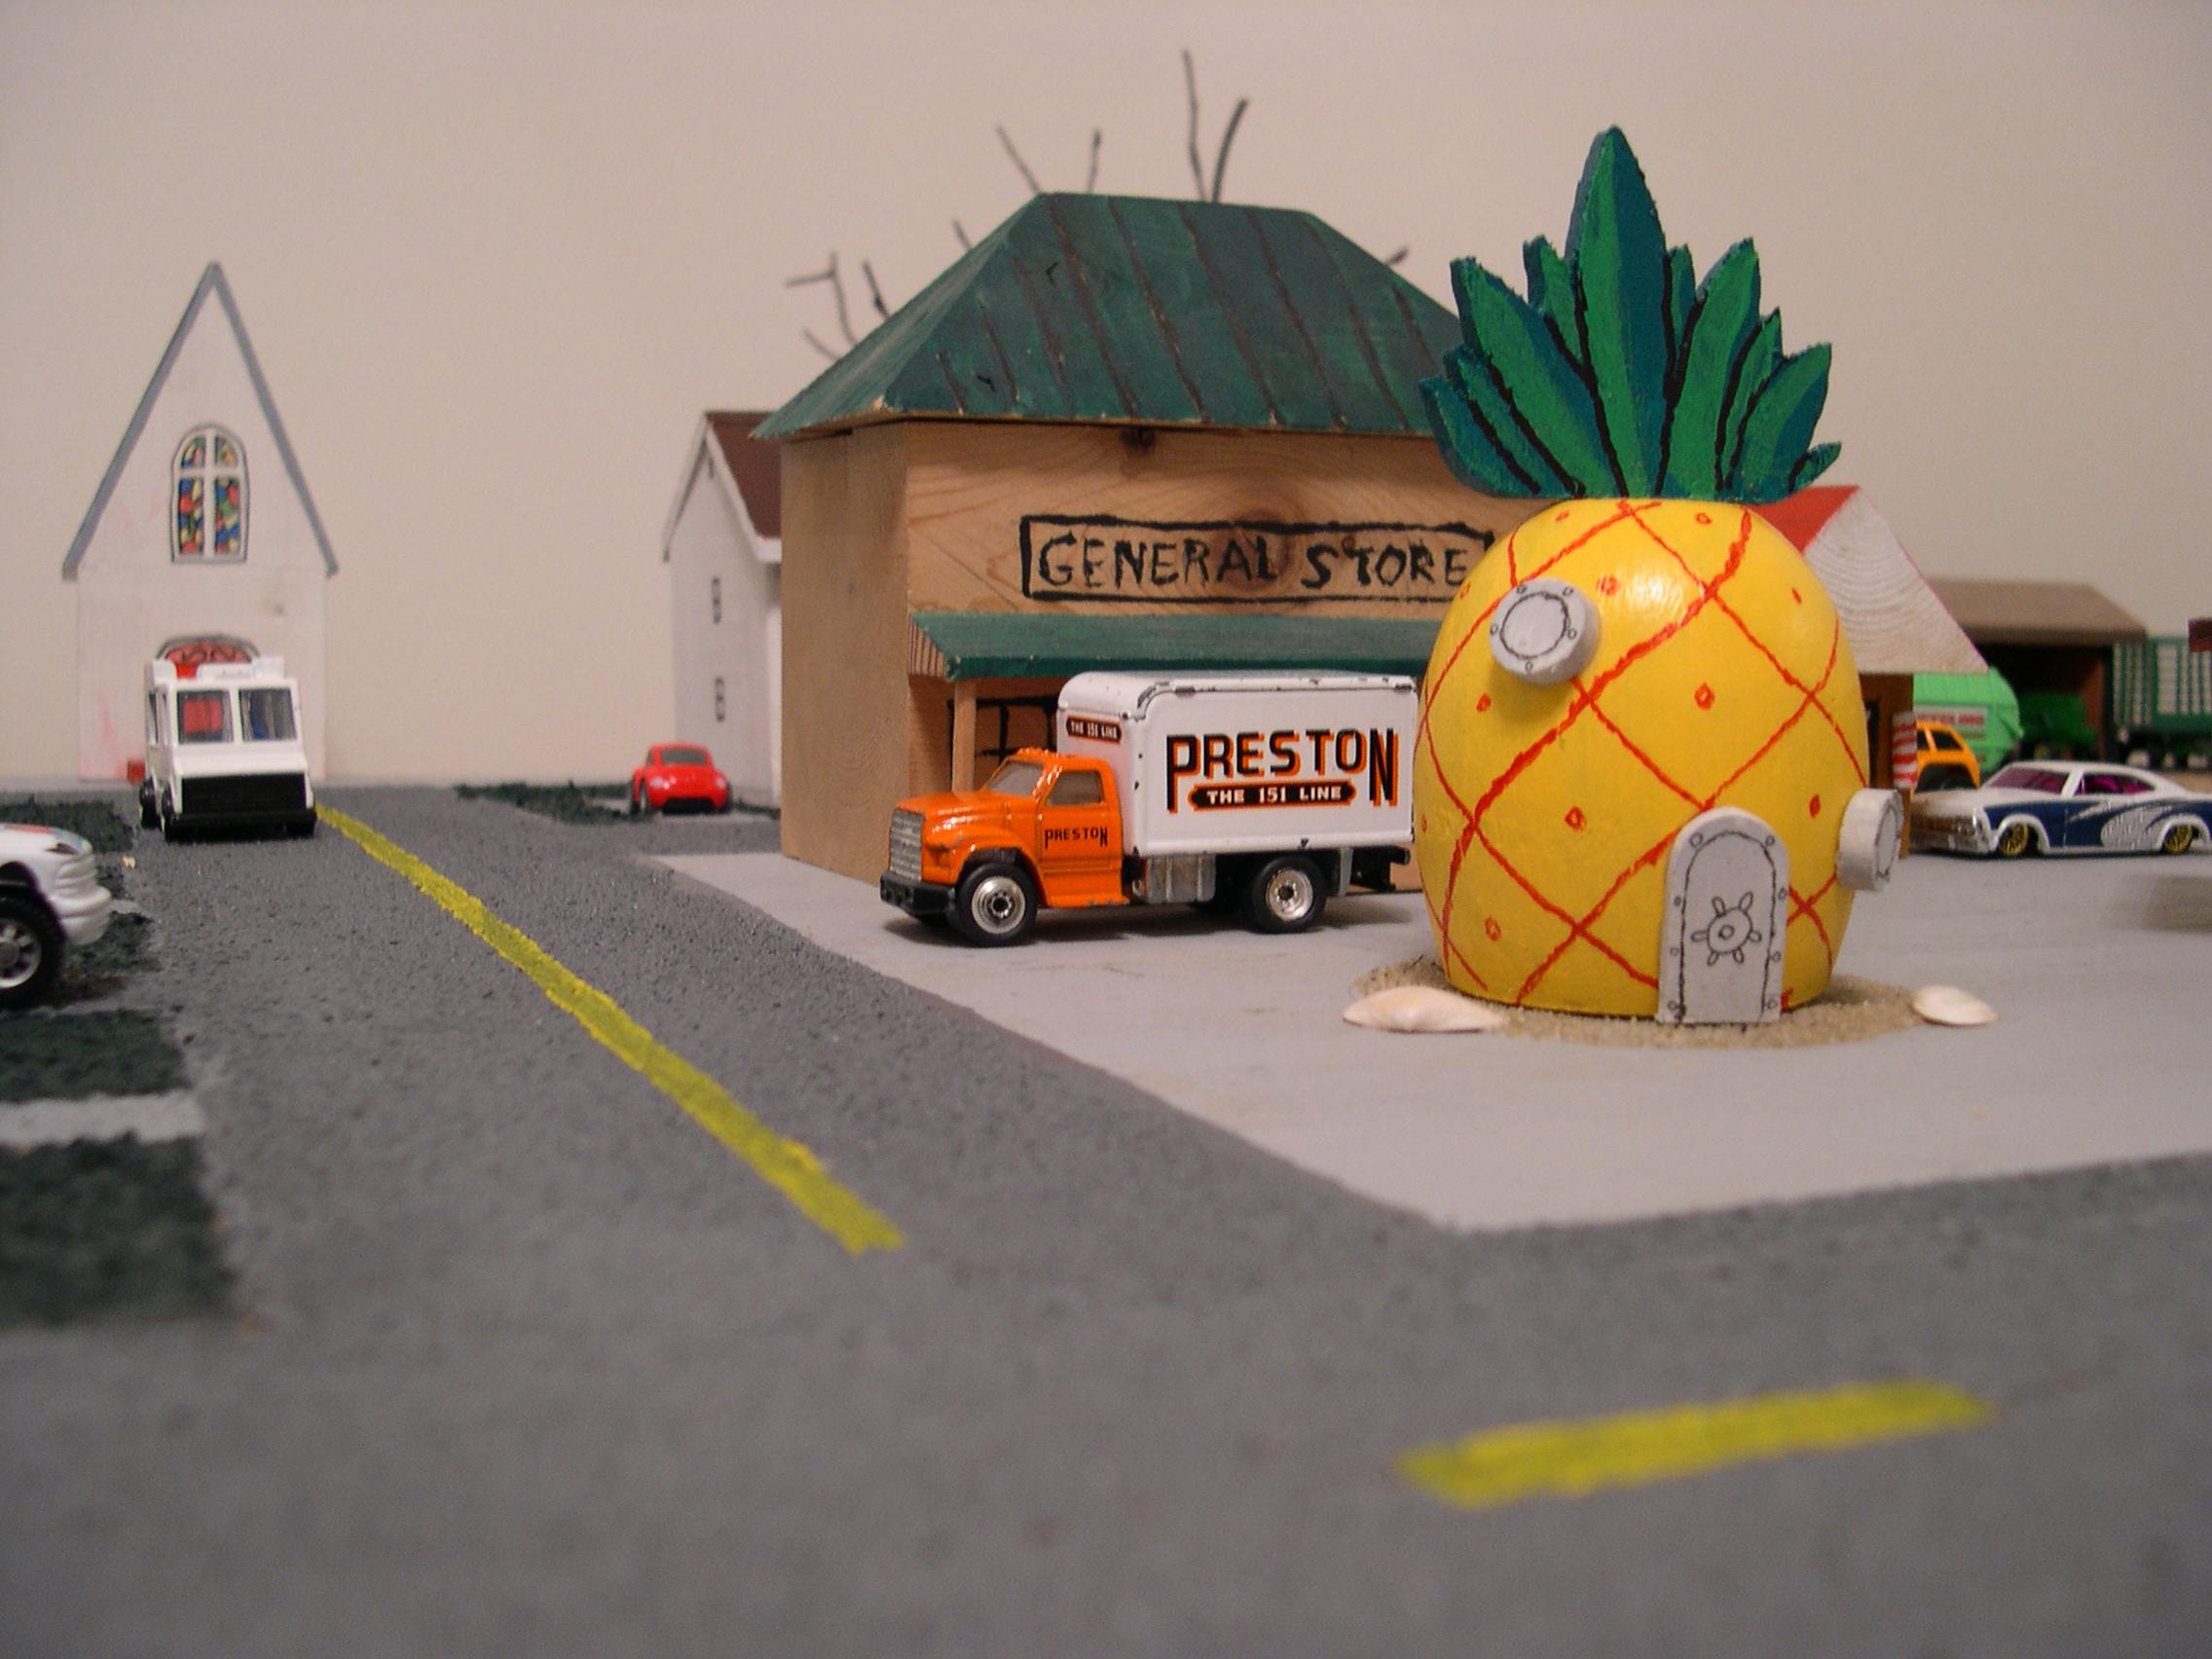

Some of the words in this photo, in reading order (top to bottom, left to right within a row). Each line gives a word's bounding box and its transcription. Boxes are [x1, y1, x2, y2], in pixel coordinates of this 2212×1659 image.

[1038, 533, 1277, 588] GENERAL
[1300, 538, 1468, 589] STORE
[1071, 720, 1084, 734] THE
[1166, 727, 1399, 815] PRESTON
[1206, 789, 1245, 805] THE
[1258, 786, 1287, 803] 151
[1299, 785, 1342, 801] LINE
[1045, 827, 1108, 850] PRESTON
